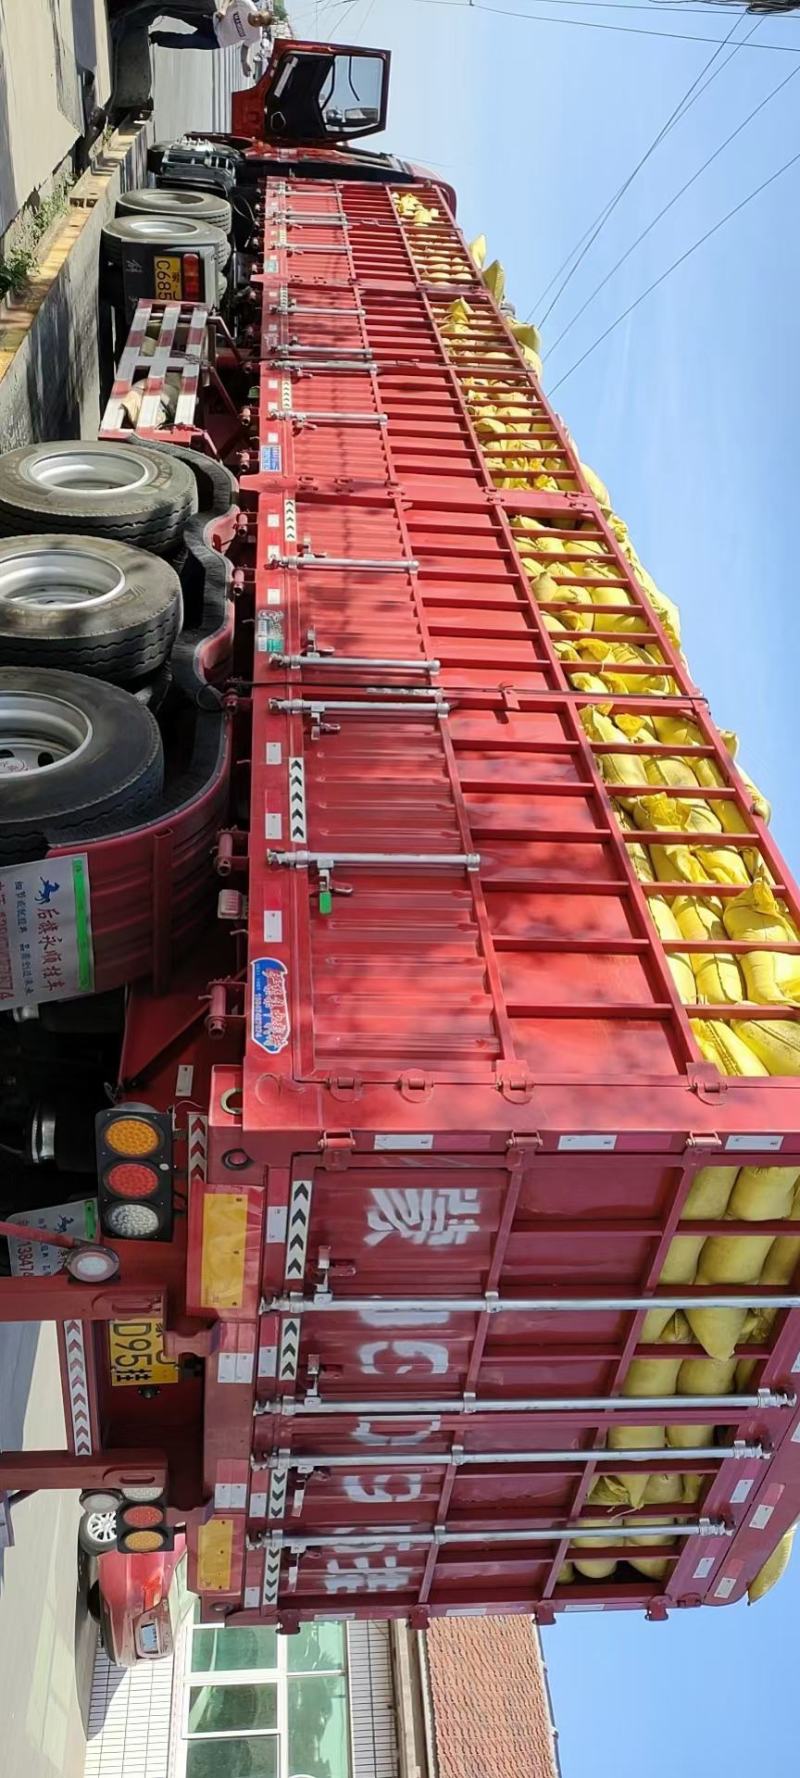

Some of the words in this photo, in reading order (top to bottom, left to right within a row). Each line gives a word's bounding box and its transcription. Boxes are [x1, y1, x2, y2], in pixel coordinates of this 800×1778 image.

[36, 908, 65, 992] 后旗永顺挂车
